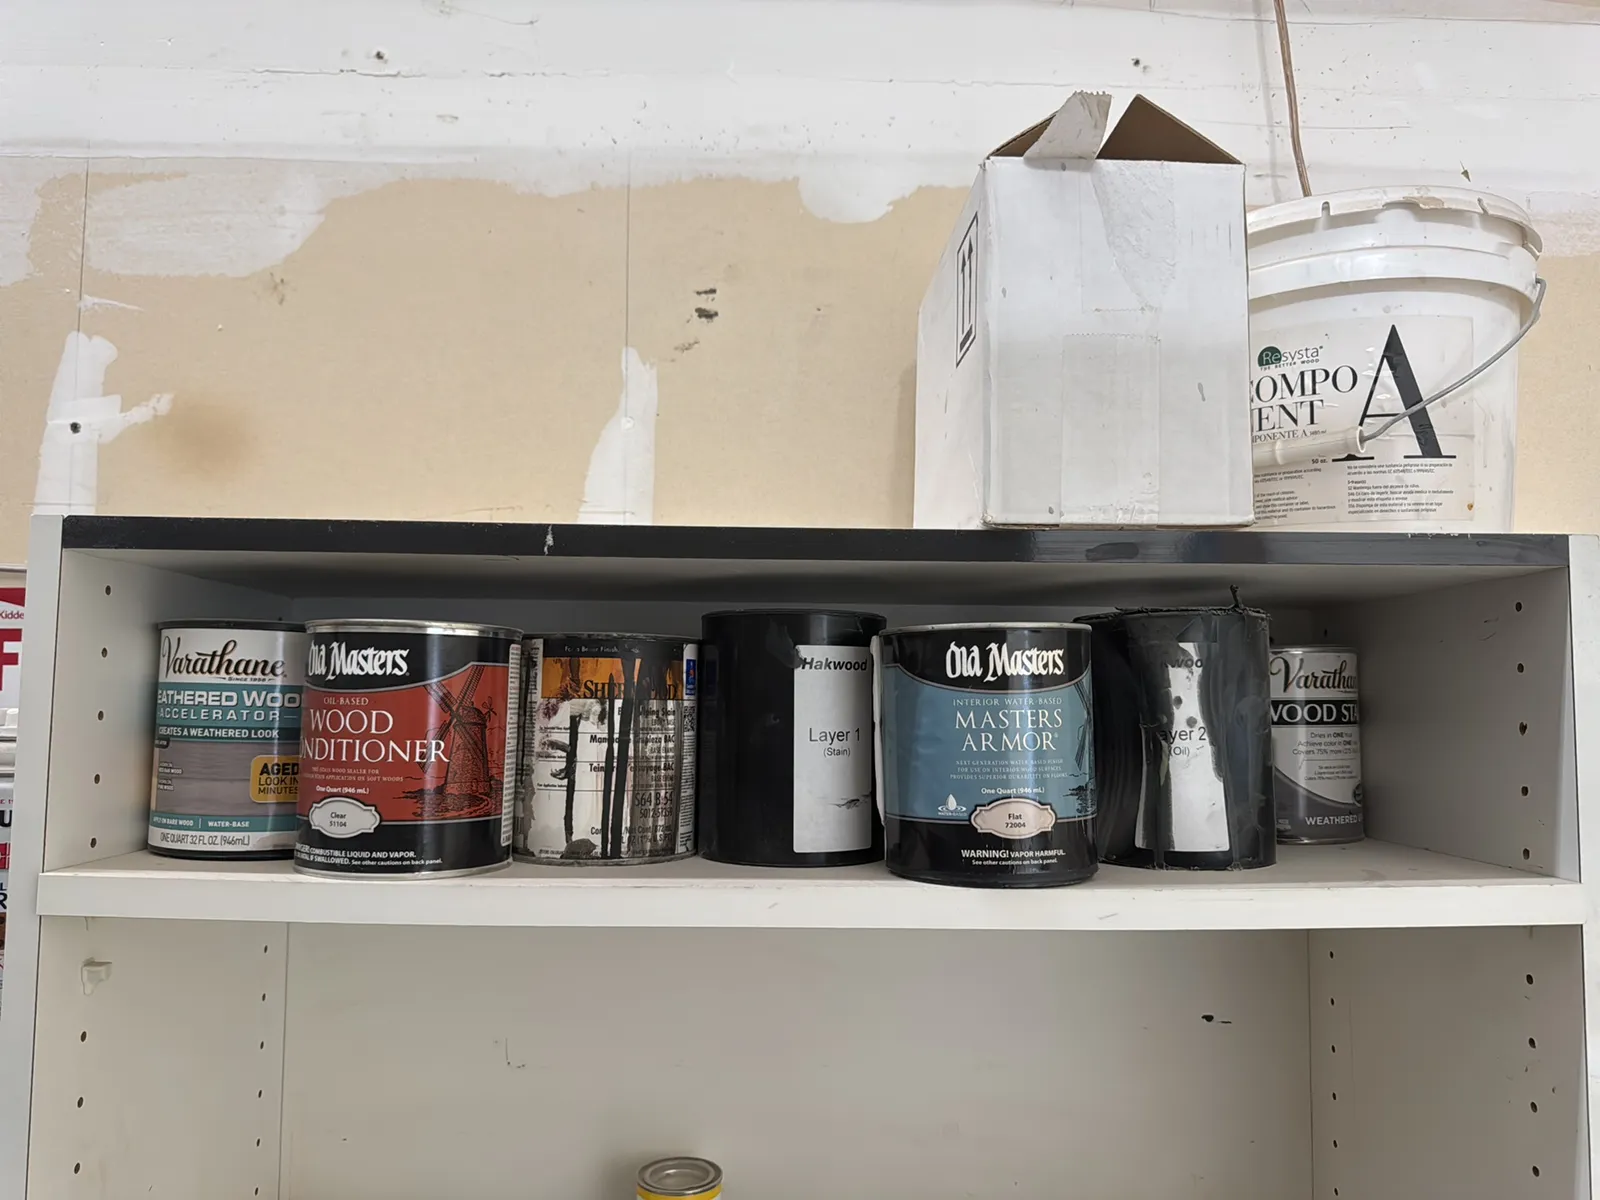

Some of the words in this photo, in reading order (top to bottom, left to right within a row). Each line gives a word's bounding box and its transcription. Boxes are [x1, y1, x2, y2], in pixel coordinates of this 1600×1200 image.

[1262, 345, 1319, 364] Resysta
[1332, 324, 1457, 463] A
[1251, 399, 1324, 433] ENT
[162, 636, 285, 679] Varathane
[308, 640, 327, 676] Old
[325, 642, 409, 681] Masters
[801, 657, 868, 671] Hakwood
[946, 641, 983, 679] Old
[983, 641, 1064, 683] Masters
[1270, 656, 1357, 693] Varatha
[158, 690, 237, 706] EATHERED
[243, 691, 301, 707] WOO
[324, 697, 369, 706] OIL-BASED
[953, 698, 1000, 706] INTERIOR
[159, 708, 280, 721] ACCELERATOR
[955, 709, 1062, 729] MASTERS
[310, 709, 393, 734] WOOD
[182, 728, 188, 736] A
[190, 728, 249, 738] WEATHERED
[251, 729, 279, 738] LOOK
[809, 727, 850, 745] Layer
[855, 728, 860, 741] 1
[1160, 727, 1194, 744] ayer
[1198, 727, 1207, 741] 2
[962, 732, 1056, 752] ARMOR
[301, 738, 450, 763] NDITIONER
[823, 747, 851, 757] (Stain)
[1169, 746, 1190, 757] (Oil)
[259, 763, 299, 775] AGED
[258, 776, 288, 786] LOOK
[258, 786, 299, 795] MINUTES
[316, 785, 327, 793] One
[342, 786, 356, 794] (946
[996, 787, 1016, 795] Quart
[208, 820, 250, 828] WATER-BASE
[329, 820, 347, 828] 51104
[1305, 815, 1357, 826] WEATHERED
[160, 832, 170, 842] ONE
[170, 833, 189, 844] QUART
[189, 835, 199, 845] 32
[199, 835, 207, 845] FL
[961, 849, 1009, 858] WARNING!
[1035, 849, 1066, 857] HARMFUL.
[314, 856, 350, 865] SWALLOWED.
